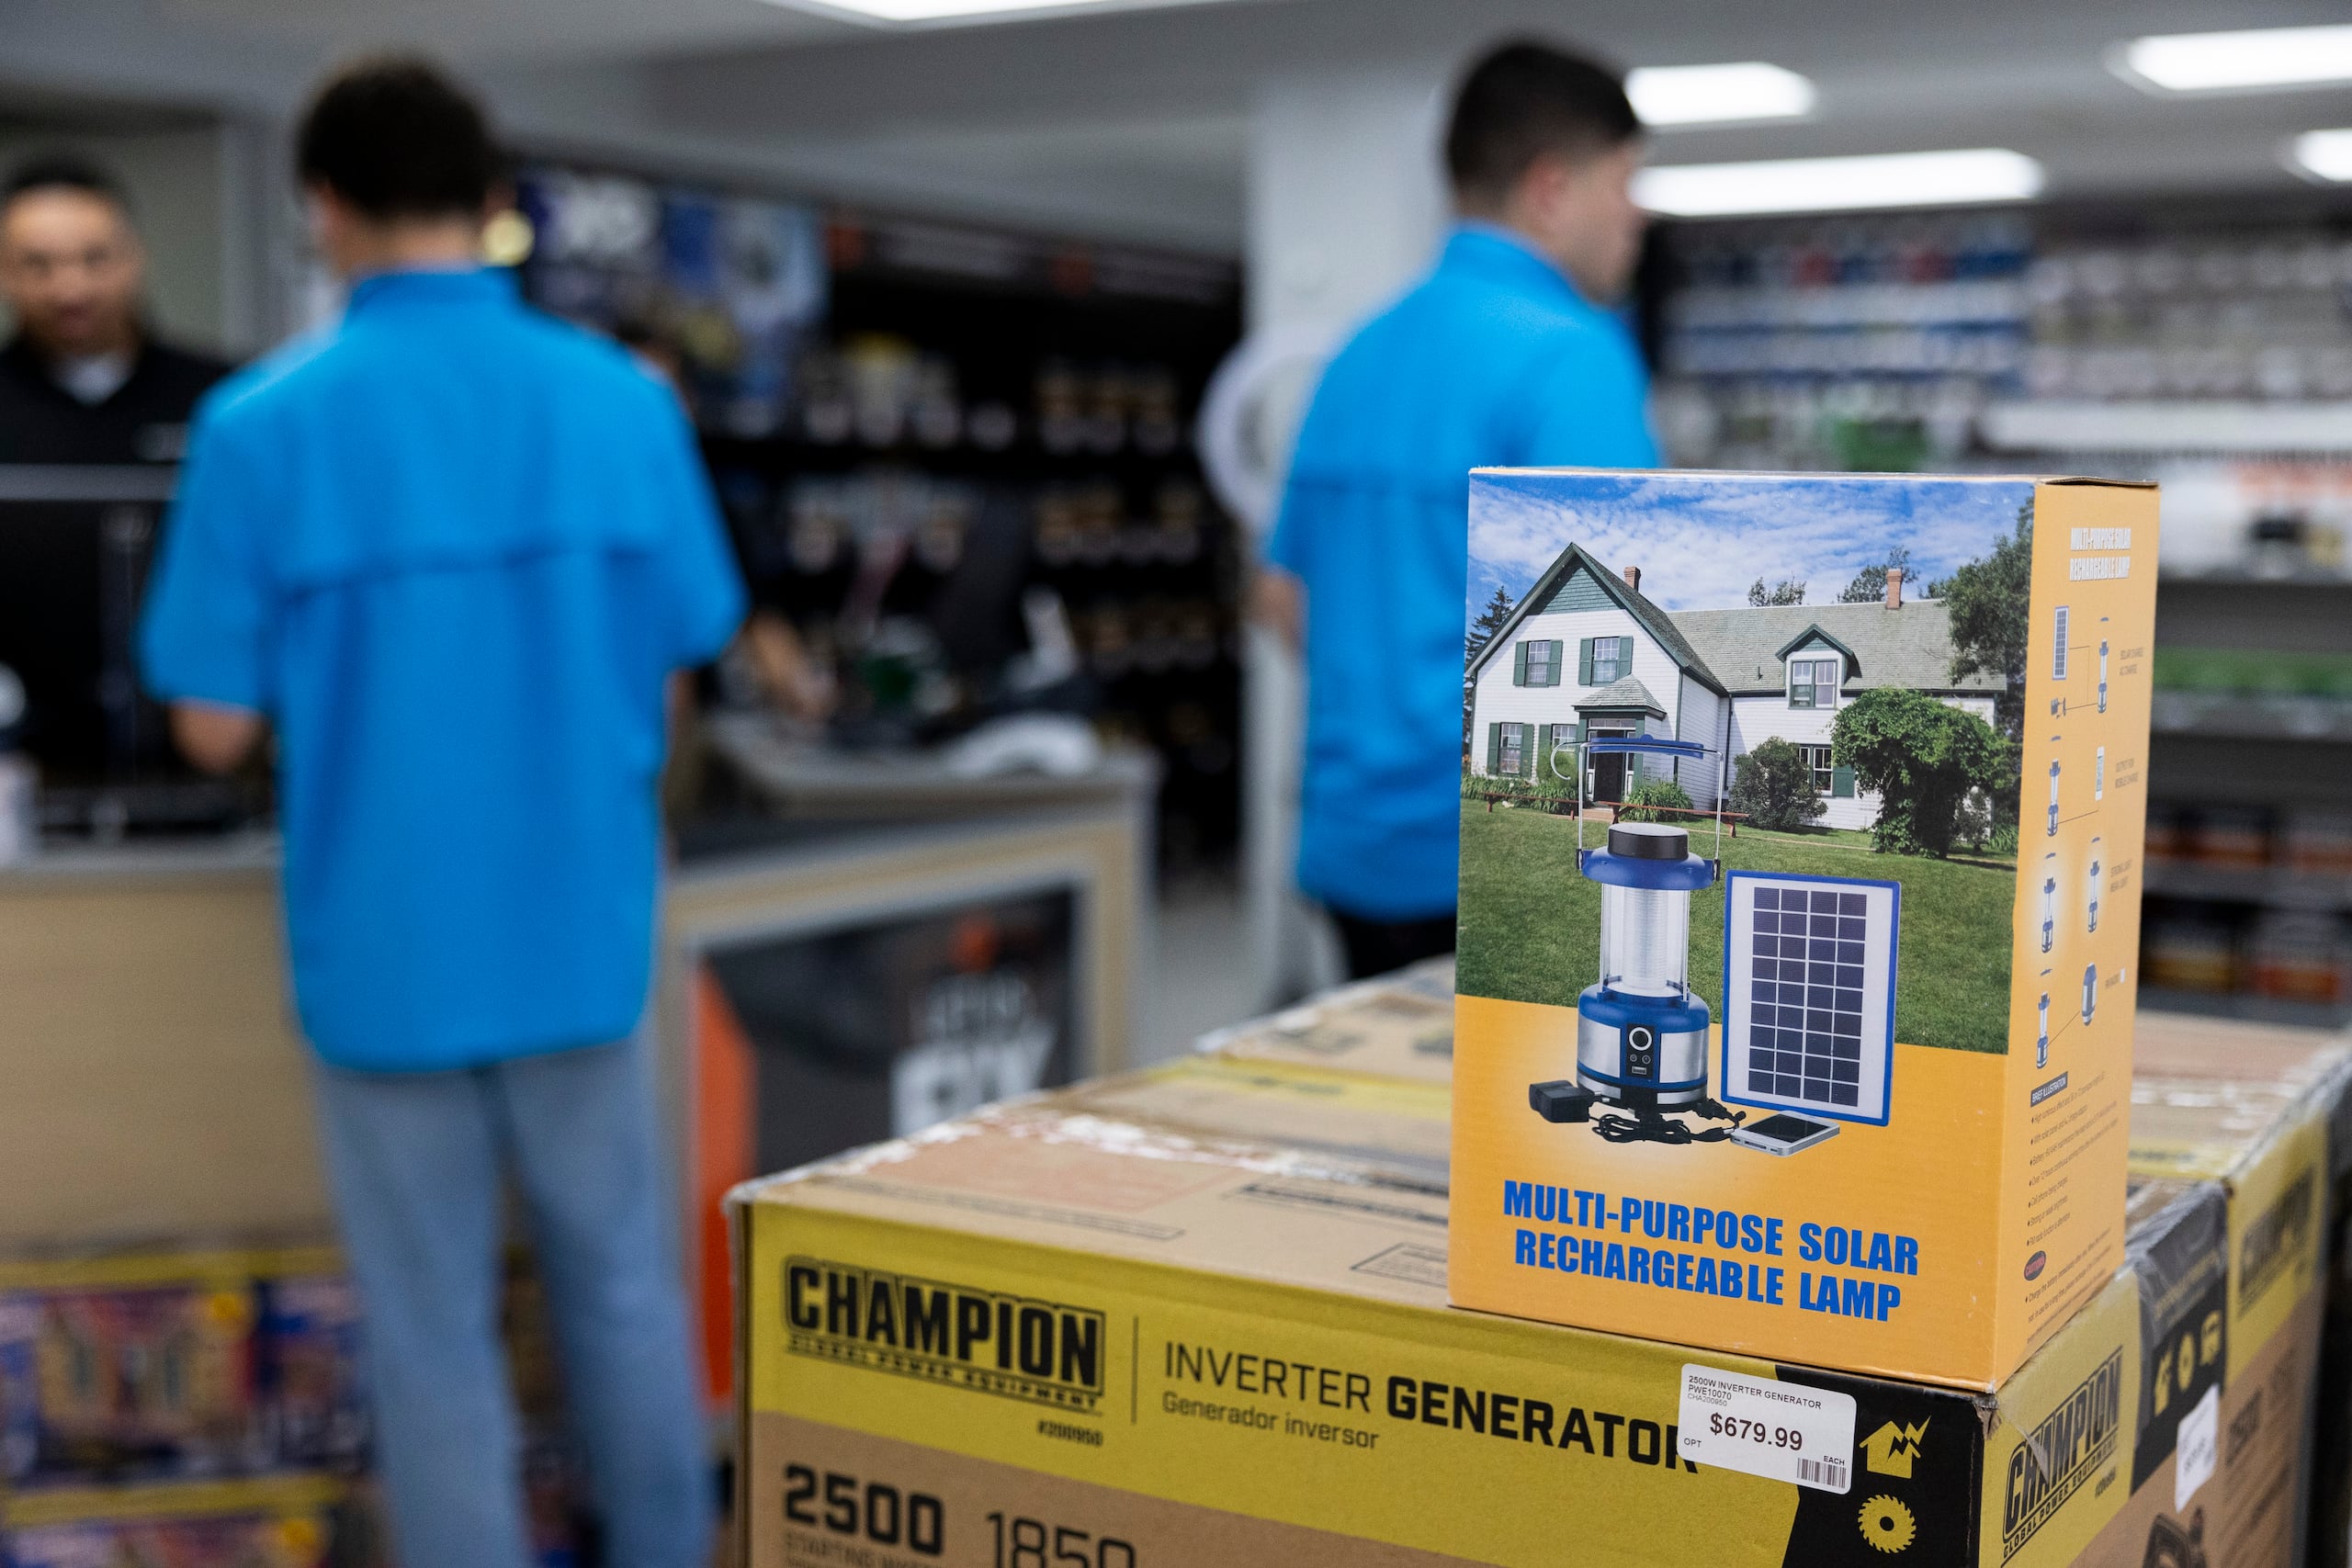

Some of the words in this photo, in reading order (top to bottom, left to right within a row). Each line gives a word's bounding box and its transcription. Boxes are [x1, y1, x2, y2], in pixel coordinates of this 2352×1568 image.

[2071, 527, 2114, 551] MULTI-PURPOSE
[2069, 558, 2115, 581] RECHARGEABLE
[2032, 1090, 2042, 1103] BRIEF
[2043, 1077, 2066, 1097] ILLUSTRATION
[1503, 1179, 1783, 1256] MULTI-PURPOSE
[1799, 1223, 1918, 1275] SOLAR
[1515, 1229, 1783, 1305] RECHARGEABLE
[1800, 1272, 1901, 1322] LAMP
[788, 1265, 1099, 1388] CHAMPION
[965, 1370, 1098, 1409] EQUIPMENT
[1166, 1341, 1370, 1414] INVERTER
[1688, 1384, 1732, 1401] PWE10070
[1689, 1375, 1718, 1388] 2500W
[1717, 1381, 1762, 1397] INVERTER
[1764, 1391, 1822, 1410] GENERATOR
[1687, 1393, 1727, 1407] CHA200950
[1162, 1390, 1279, 1431] Generador
[1284, 1411, 1380, 1450] inversor
[1710, 1412, 1803, 1451] $679.99
[1683, 1438, 1702, 1449] OPT
[1823, 1455, 1845, 1466] EACH
[2005, 1353, 2122, 1535] CHAMPION
[785, 1462, 944, 1557] 2500
[2004, 1521, 2037, 1559] GLOBAL
[2039, 1486, 2069, 1522] POWER
